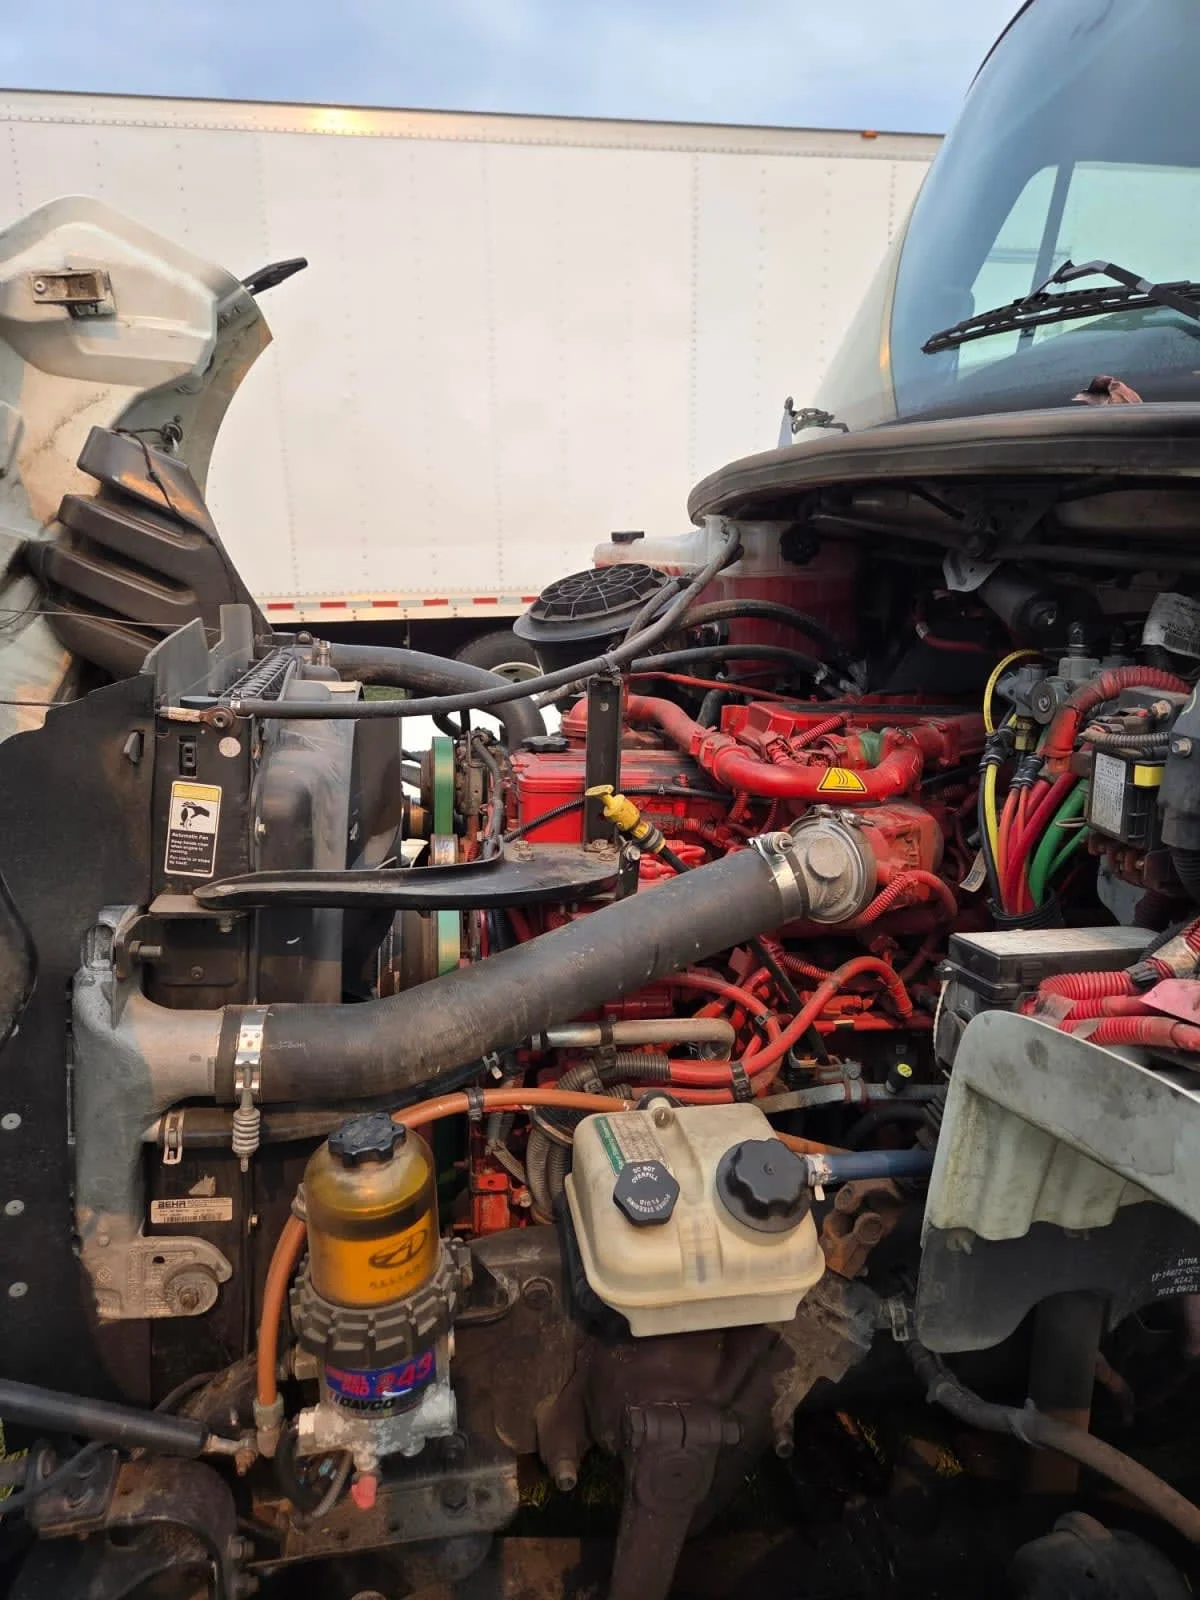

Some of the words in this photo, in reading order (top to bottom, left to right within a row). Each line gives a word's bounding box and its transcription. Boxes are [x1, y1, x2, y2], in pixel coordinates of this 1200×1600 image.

[632, 1166, 641, 1174] DO
[631, 1172, 659, 1184] OVERFILL
[158, 1200, 187, 1209] BEHR
[639, 1197, 661, 1207] FLUID
[339, 1397, 397, 1410] DAVCO
